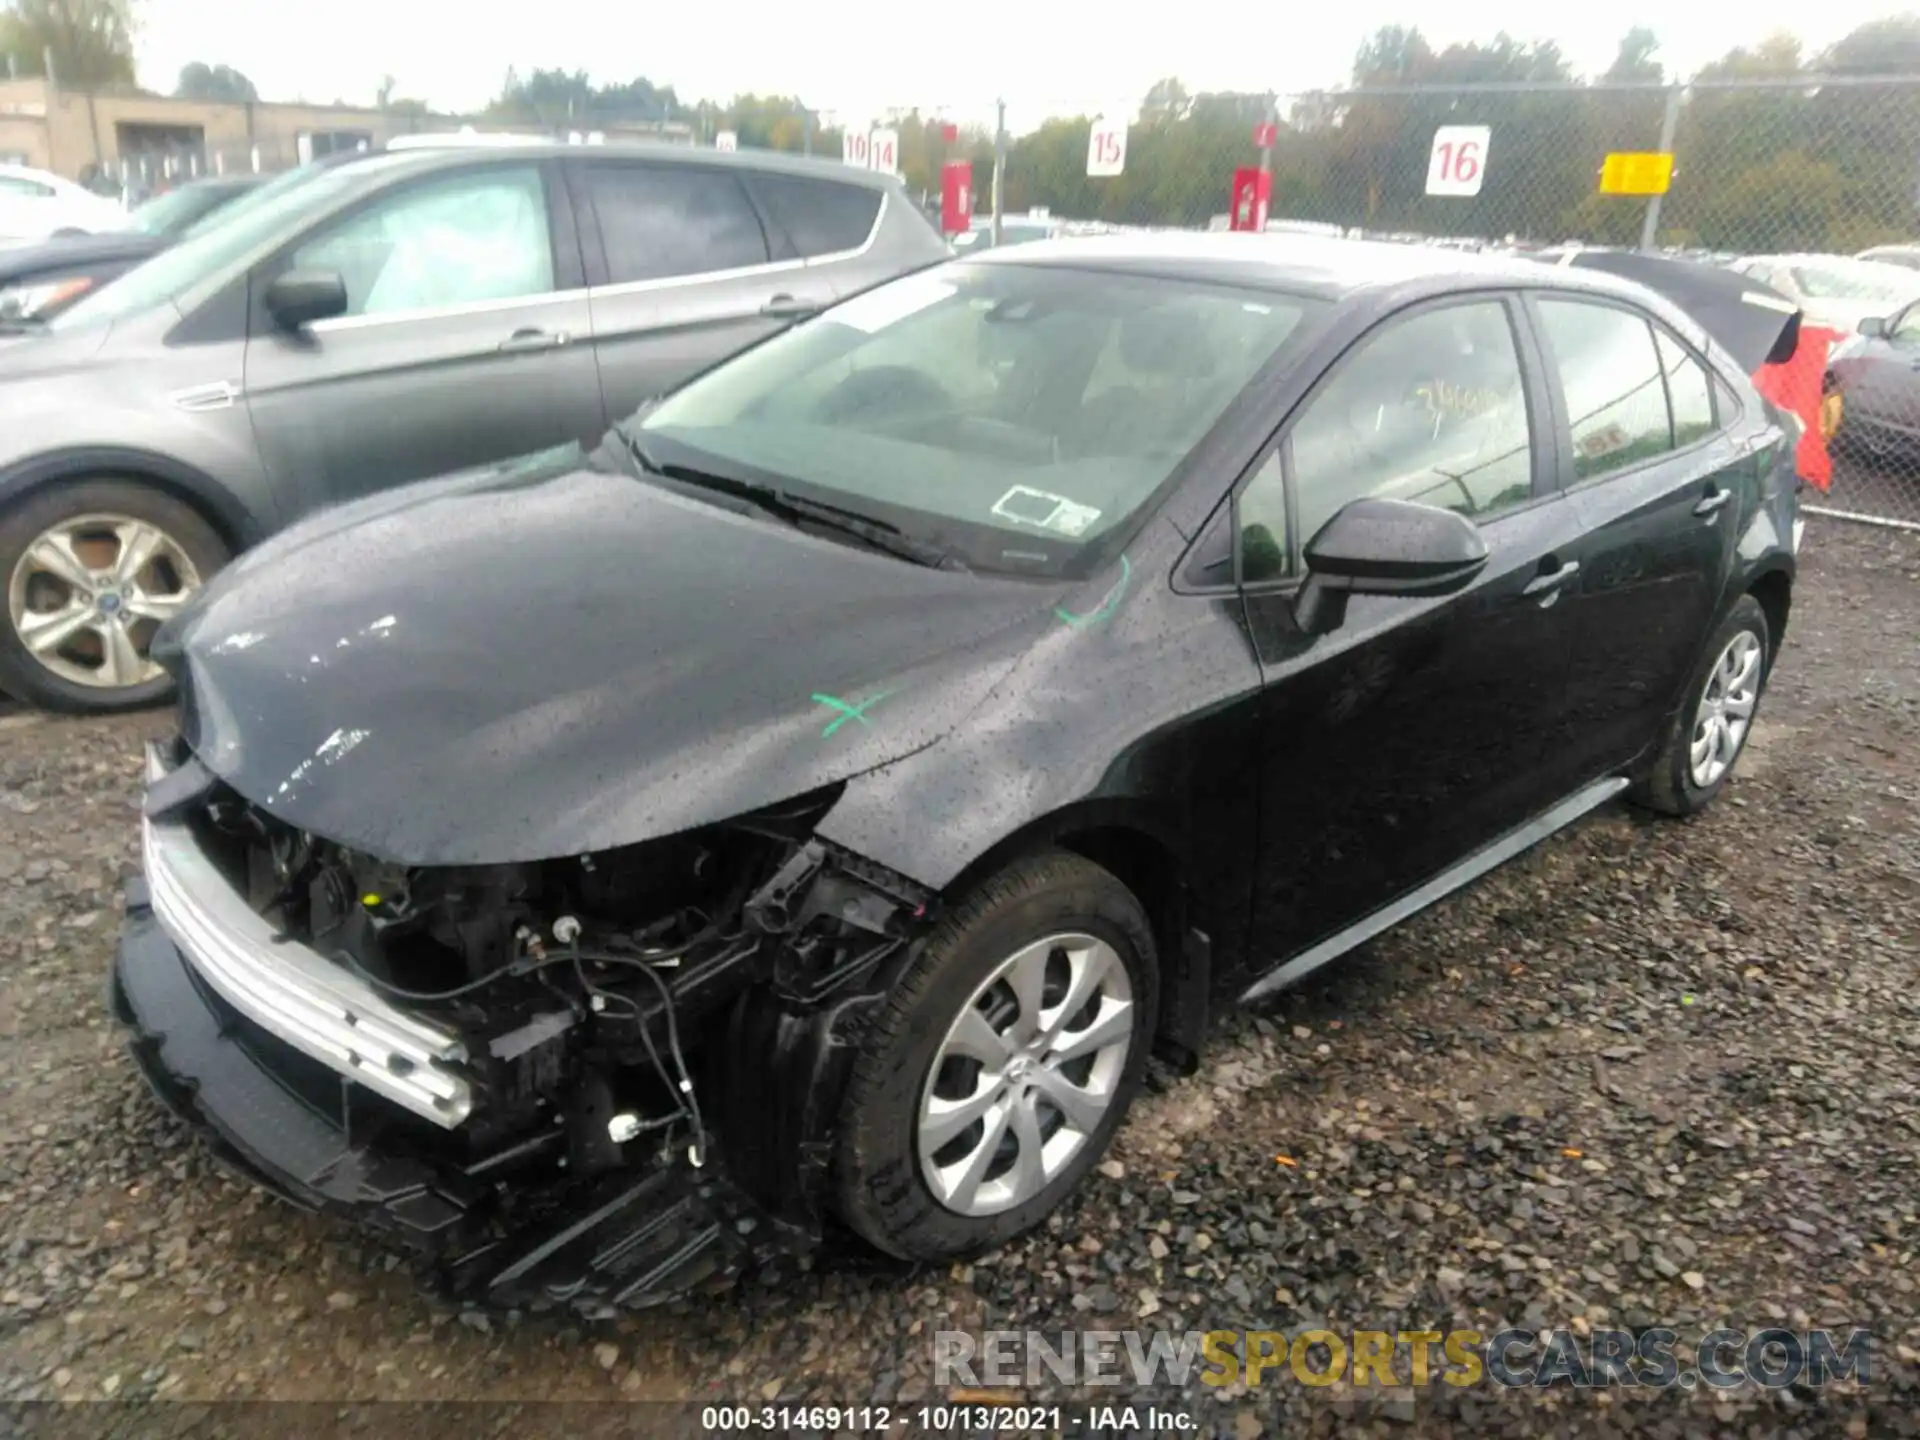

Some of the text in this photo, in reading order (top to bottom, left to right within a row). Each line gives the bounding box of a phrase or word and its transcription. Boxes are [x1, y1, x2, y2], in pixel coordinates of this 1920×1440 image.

[873, 141, 893, 171] 14
[1095, 131, 1121, 165] 15
[1437, 141, 1480, 182] 16
